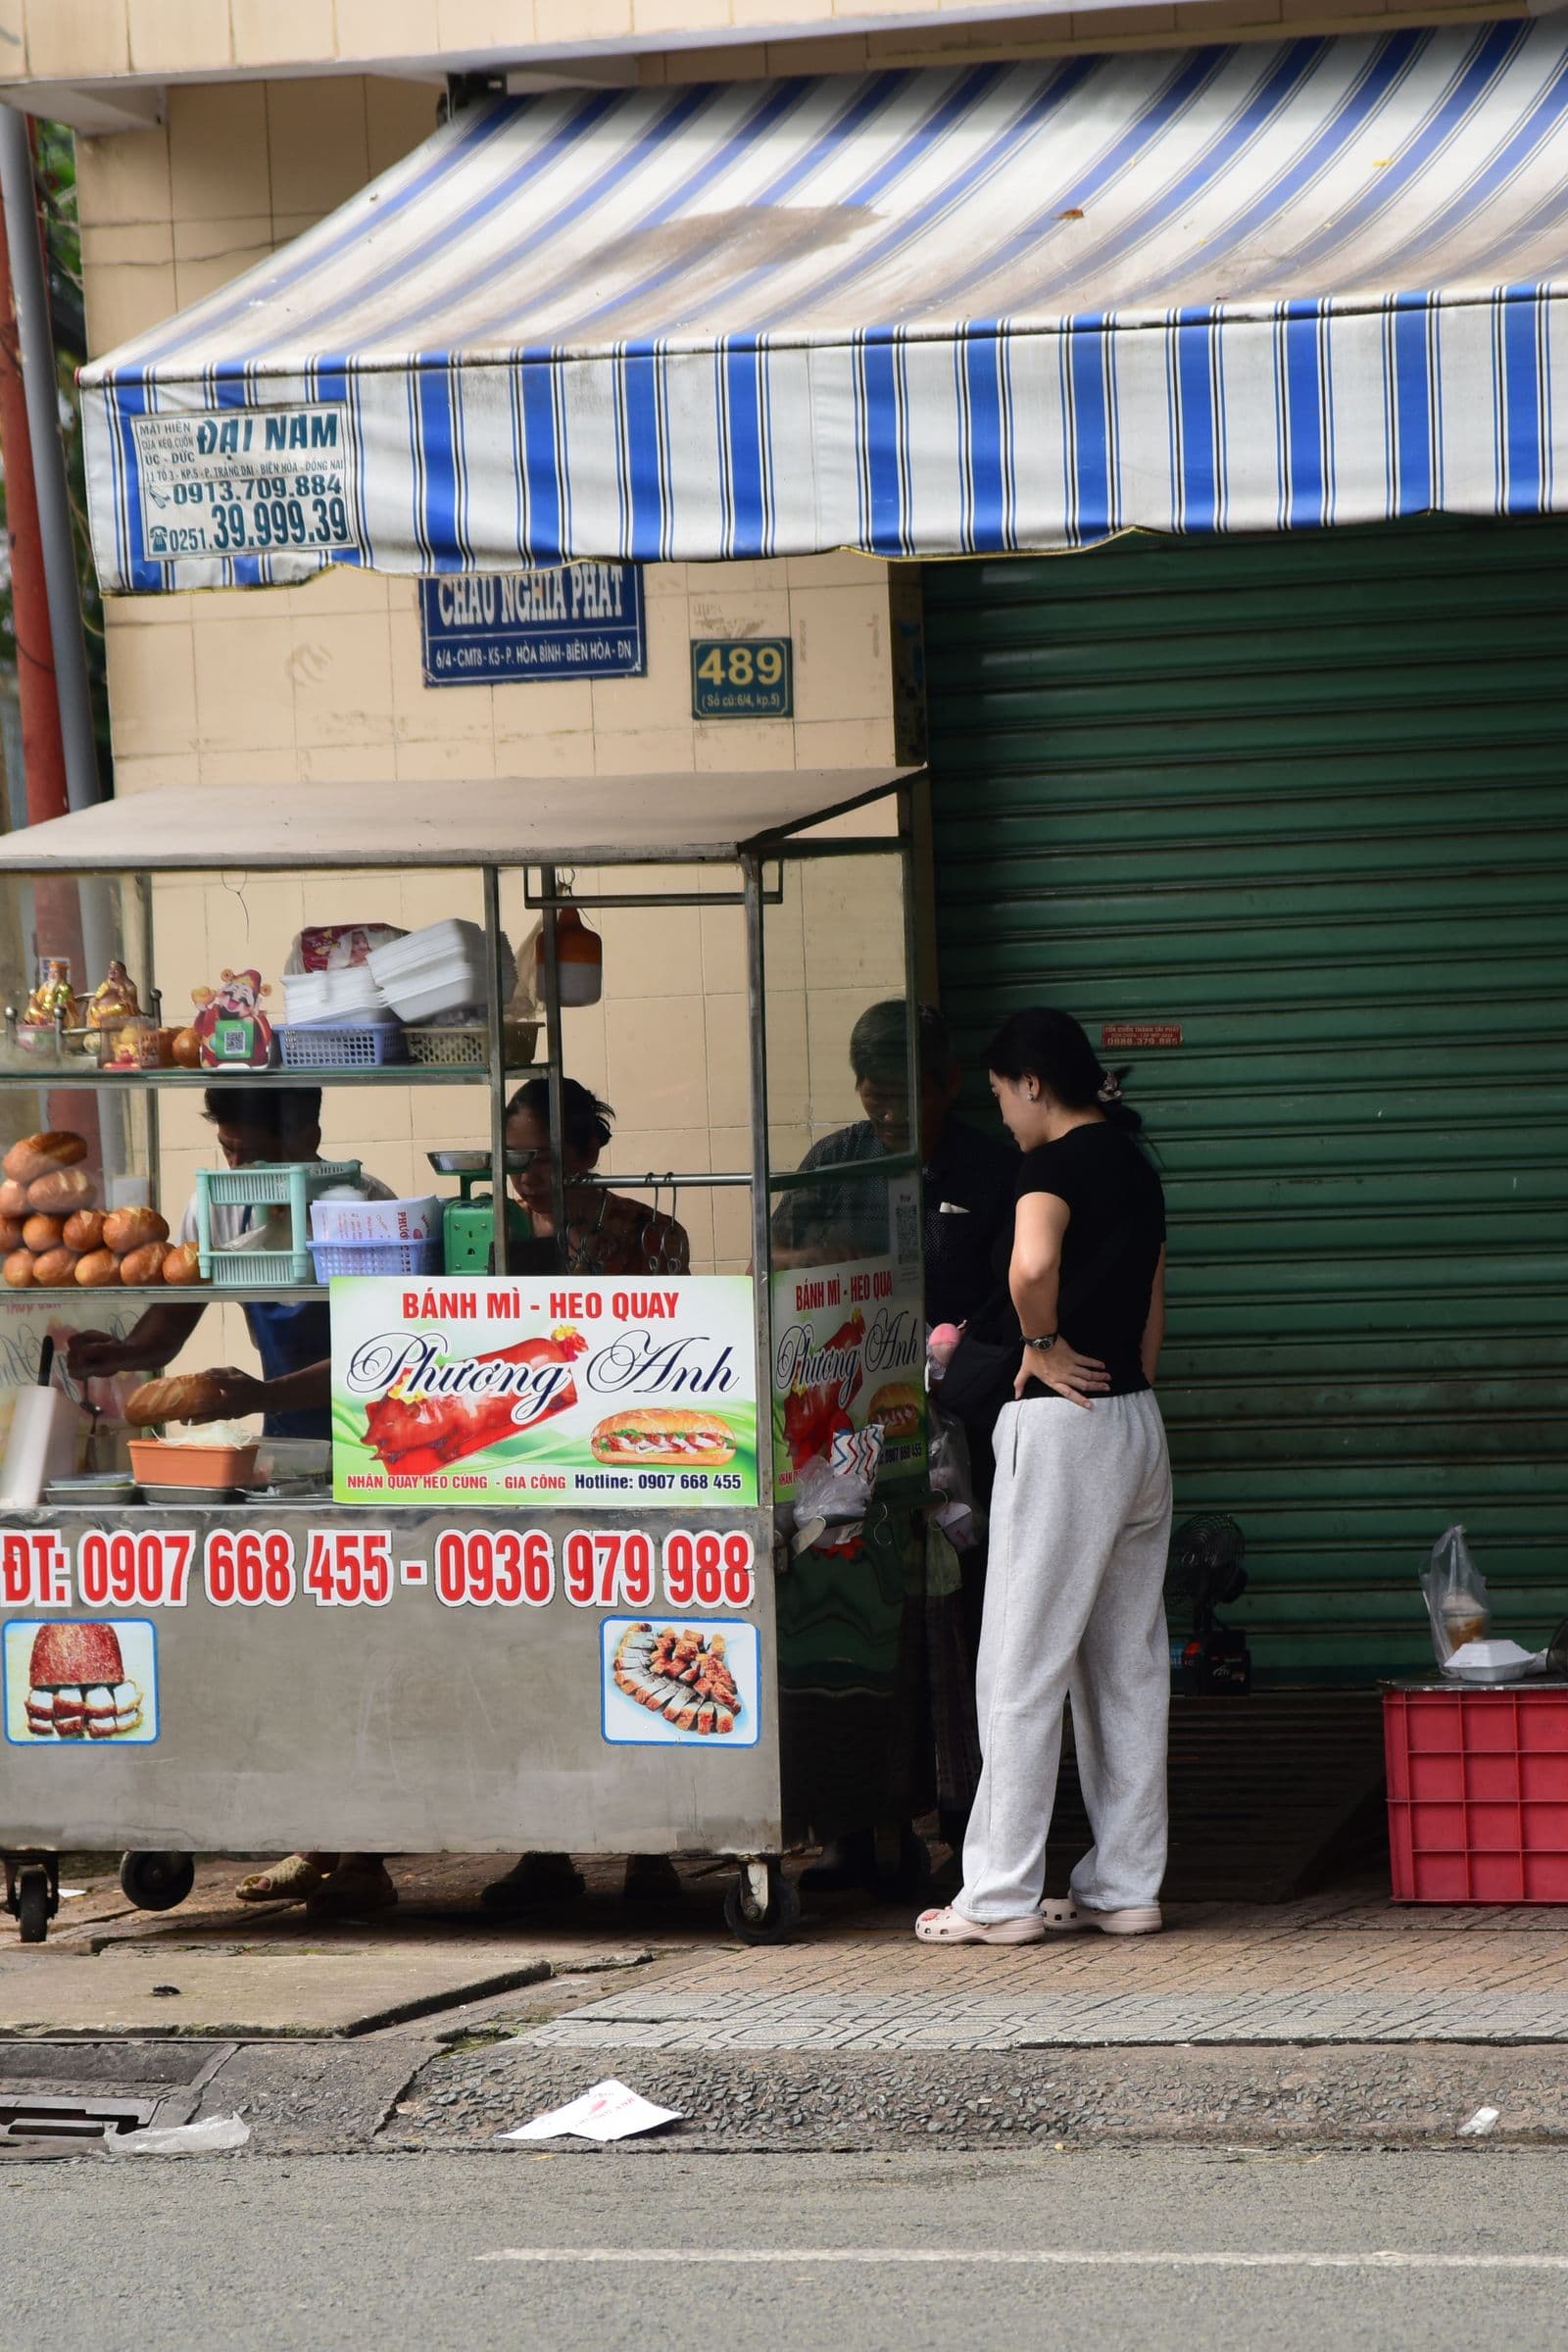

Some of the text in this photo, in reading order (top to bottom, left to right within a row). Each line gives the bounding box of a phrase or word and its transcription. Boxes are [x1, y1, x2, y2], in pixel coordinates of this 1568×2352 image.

[196, 413, 338, 461] ĐẠI NAM
[172, 474, 342, 506] 0913.709.884
[515, 639, 537, 663] HÒA
[539, 639, 561, 663] BÌNH
[590, 635, 612, 660] HÒA
[697, 647, 783, 686] 489
[402, 1287, 477, 1319] BÁNH
[486, 1287, 520, 1319] MÌ
[549, 1292, 603, 1319] HEO
[612, 1292, 680, 1322] QUAY
[795, 1277, 824, 1312] BÁNH
[827, 1272, 840, 1307] MÌ
[850, 1274, 870, 1303] HEO
[347, 1329, 740, 1421] Phương Anh
[776, 1307, 920, 1407] Phương Anh
[347, 1473, 383, 1492] NHẬN
[387, 1475, 418, 1490] QUAY
[422, 1475, 449, 1489] HEO
[505, 1475, 526, 1489] GIA
[530, 1473, 565, 1490] CÔNG
[574, 1474, 633, 1490] Hotline:
[638, 1474, 675, 1490] 0907
[680, 1474, 709, 1490] 668
[712, 1474, 742, 1490] 455
[1, 1534, 66, 1602] ĐT:
[82, 1534, 192, 1602] 0907
[208, 1534, 291, 1602] 668
[307, 1534, 390, 1602] 455
[438, 1533, 554, 1603] 0936
[566, 1533, 653, 1603] 979
[666, 1533, 751, 1603] 988
